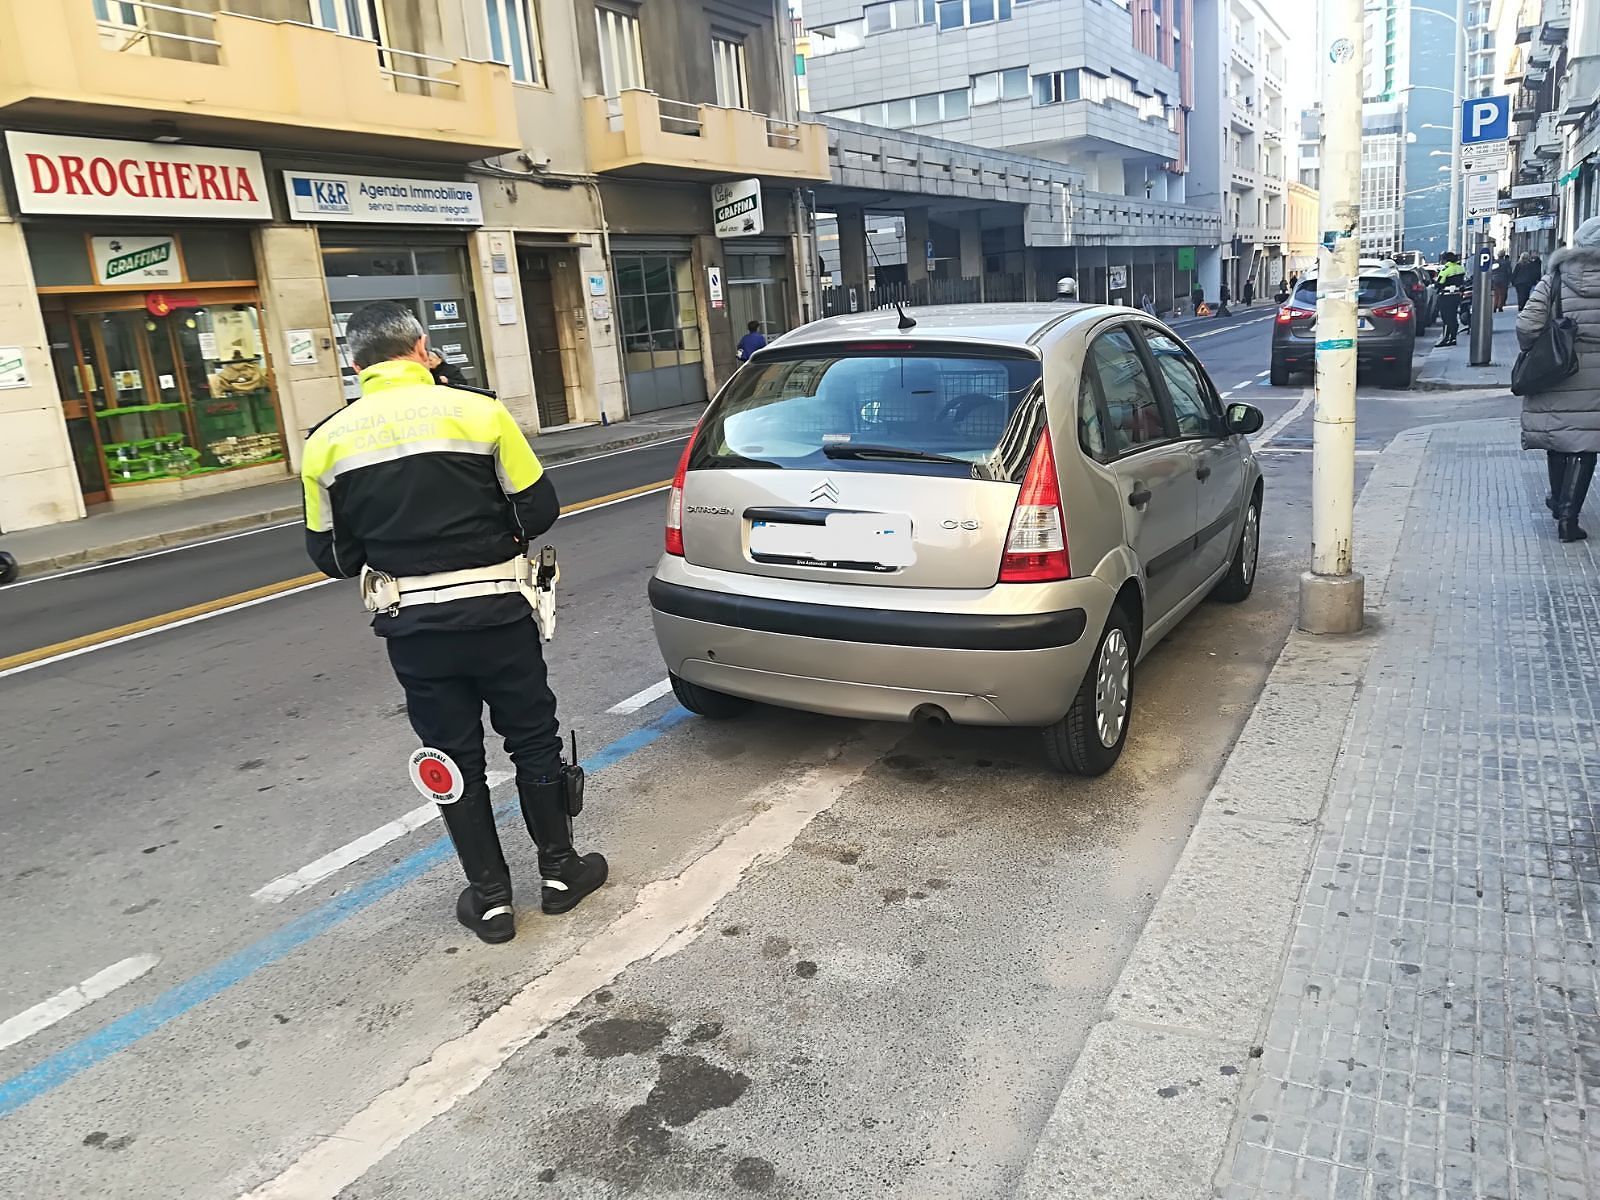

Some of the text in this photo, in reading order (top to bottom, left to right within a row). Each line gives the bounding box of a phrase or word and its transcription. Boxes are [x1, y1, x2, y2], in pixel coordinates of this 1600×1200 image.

[1472, 103, 1499, 137] P
[25, 153, 259, 202] DROGHERIA
[313, 181, 349, 205] K&R
[359, 182, 473, 201] Agenzia Immobiliare
[368, 202, 470, 216] servizi immobiliari integrati
[718, 197, 755, 221] GRAFFINA
[108, 246, 167, 275] GRAFFINA
[1480, 254, 1490, 266] P
[328, 407, 463, 442] POLIZIA LOCALE
[354, 423, 436, 449] CAGLIARI
[939, 518, 980, 531] C3
[427, 752, 446, 763] LOCALE
